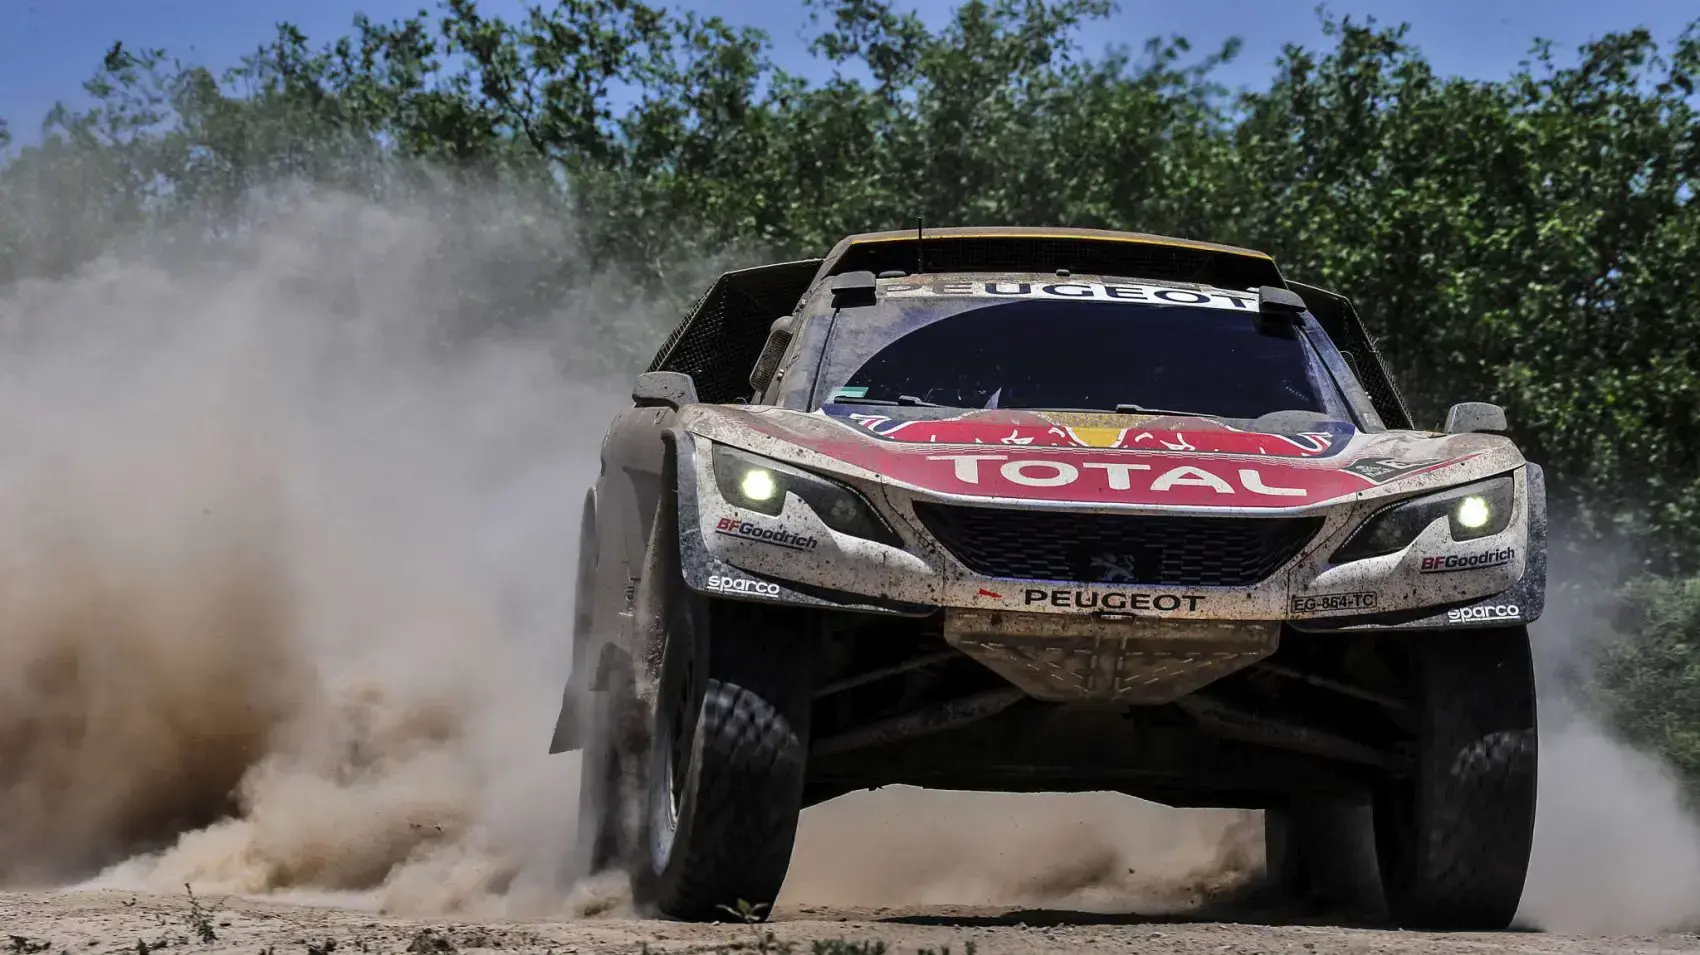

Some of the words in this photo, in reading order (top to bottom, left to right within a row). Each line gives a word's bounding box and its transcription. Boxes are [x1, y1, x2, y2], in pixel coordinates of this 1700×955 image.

[925, 454, 1308, 497] TOTAL
[715, 517, 818, 550] BFGoodrich
[1420, 547, 1515, 571] BFGoodrich
[707, 574, 780, 597] sparco
[1025, 588, 1206, 612] PEUGEOT
[1294, 593, 1375, 611] EG-864-TC
[1447, 604, 1520, 623] sparco
